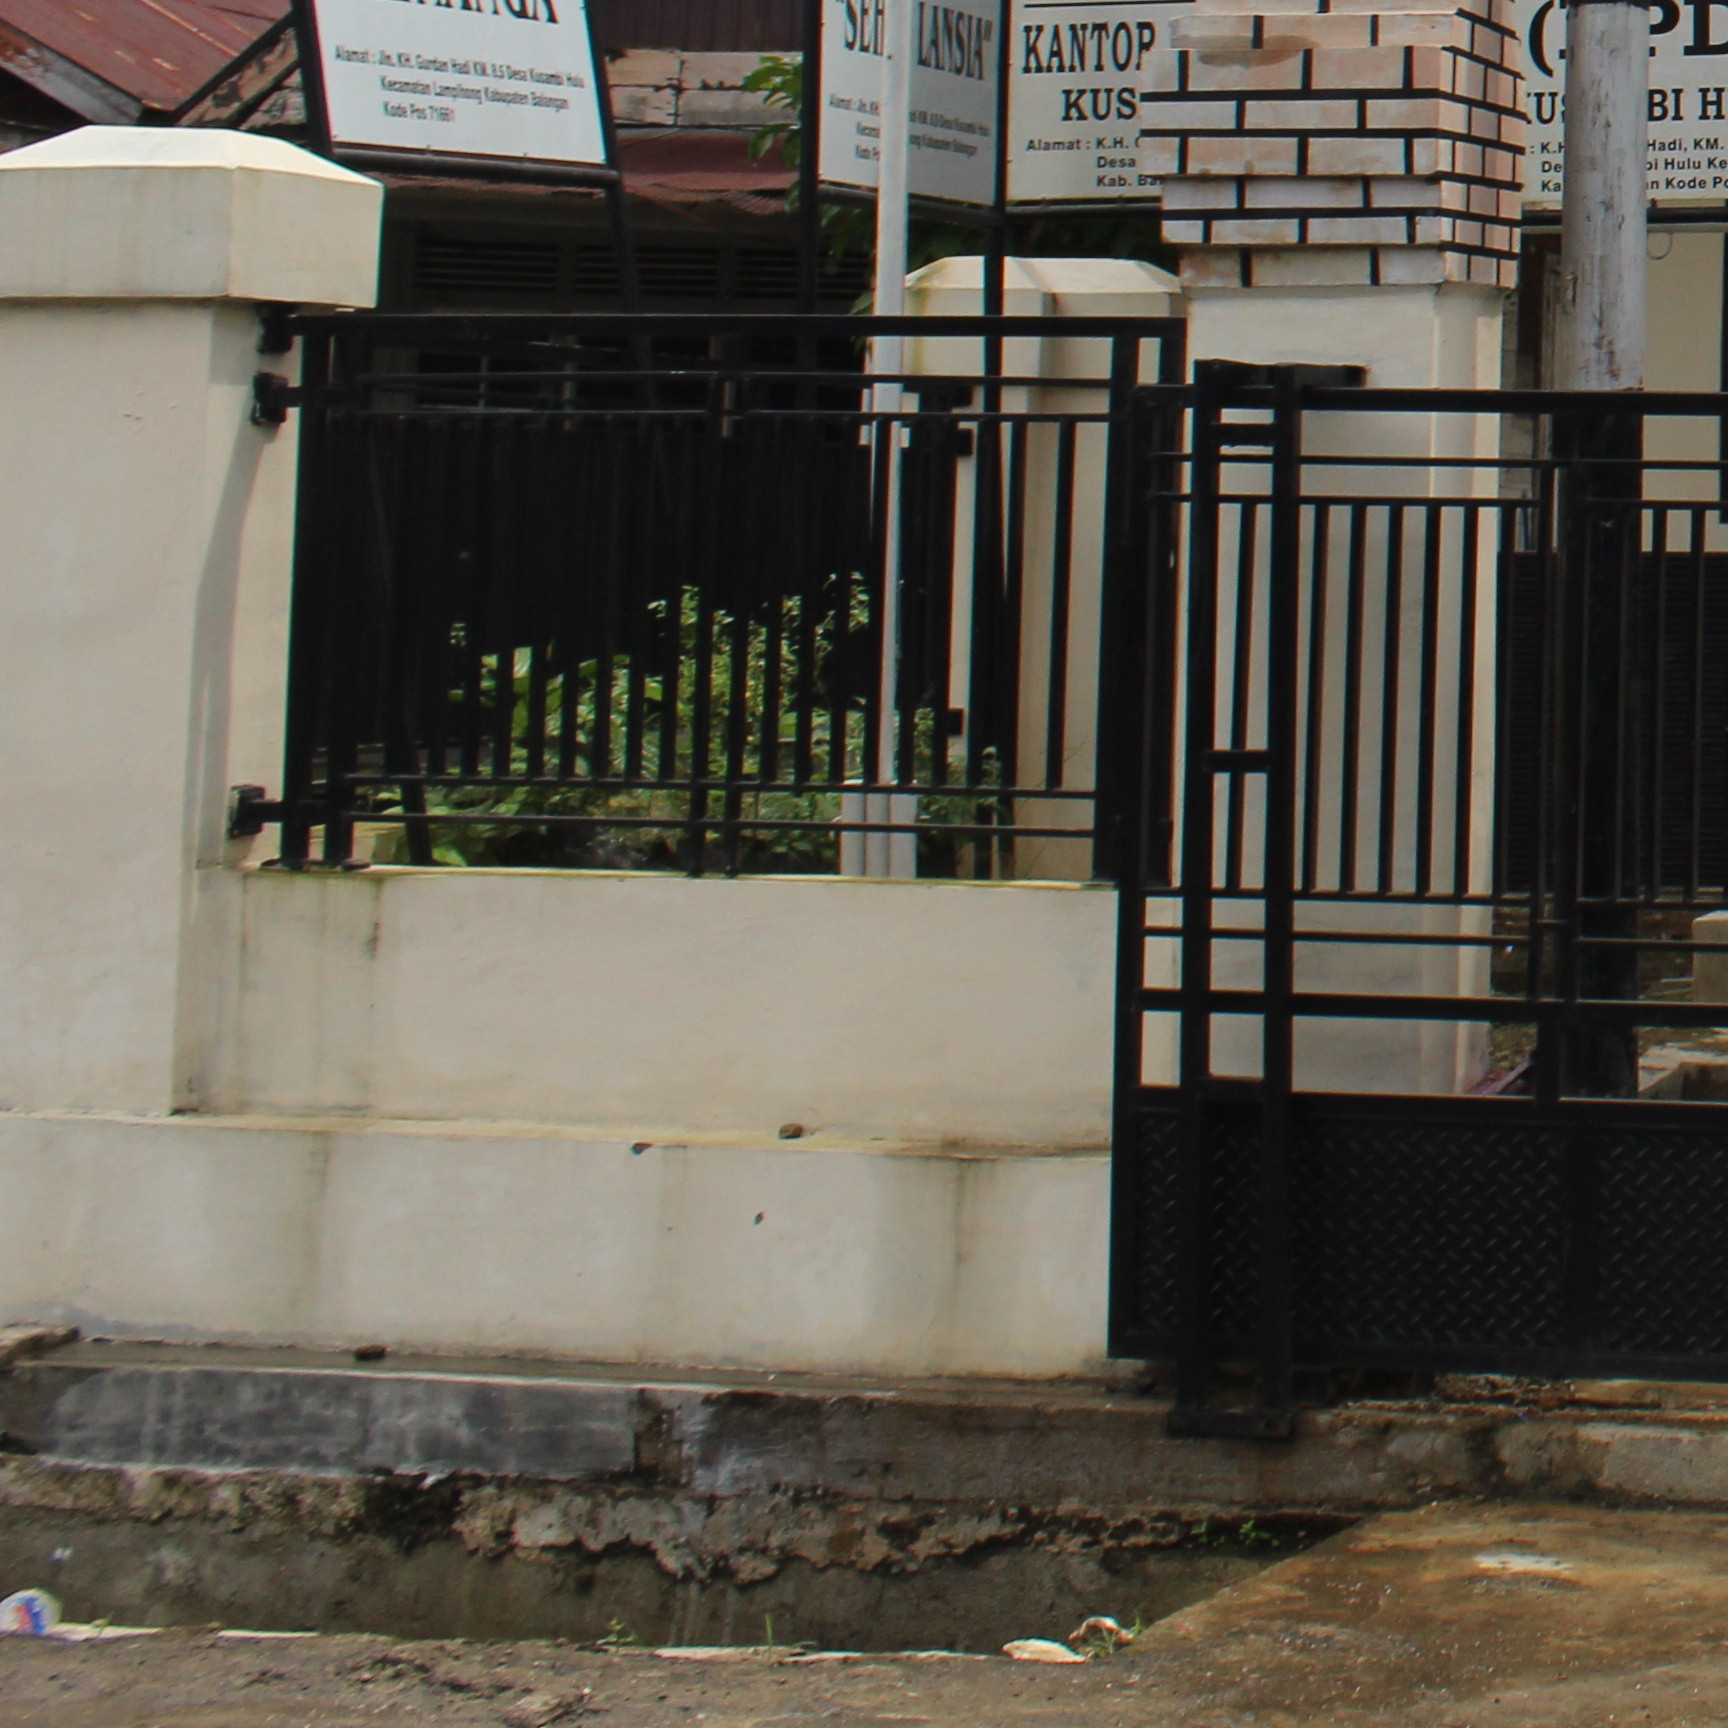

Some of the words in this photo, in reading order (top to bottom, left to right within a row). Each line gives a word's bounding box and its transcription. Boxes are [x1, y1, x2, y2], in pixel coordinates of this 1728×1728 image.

[1026, 138, 1082, 151] Alamat
[1693, 138, 1725, 151] KM.
[1097, 156, 1137, 169] Desa
[1664, 157, 1702, 171] Hulu
[1097, 175, 1133, 188] Kab.
[1665, 176, 1708, 191] Kode
